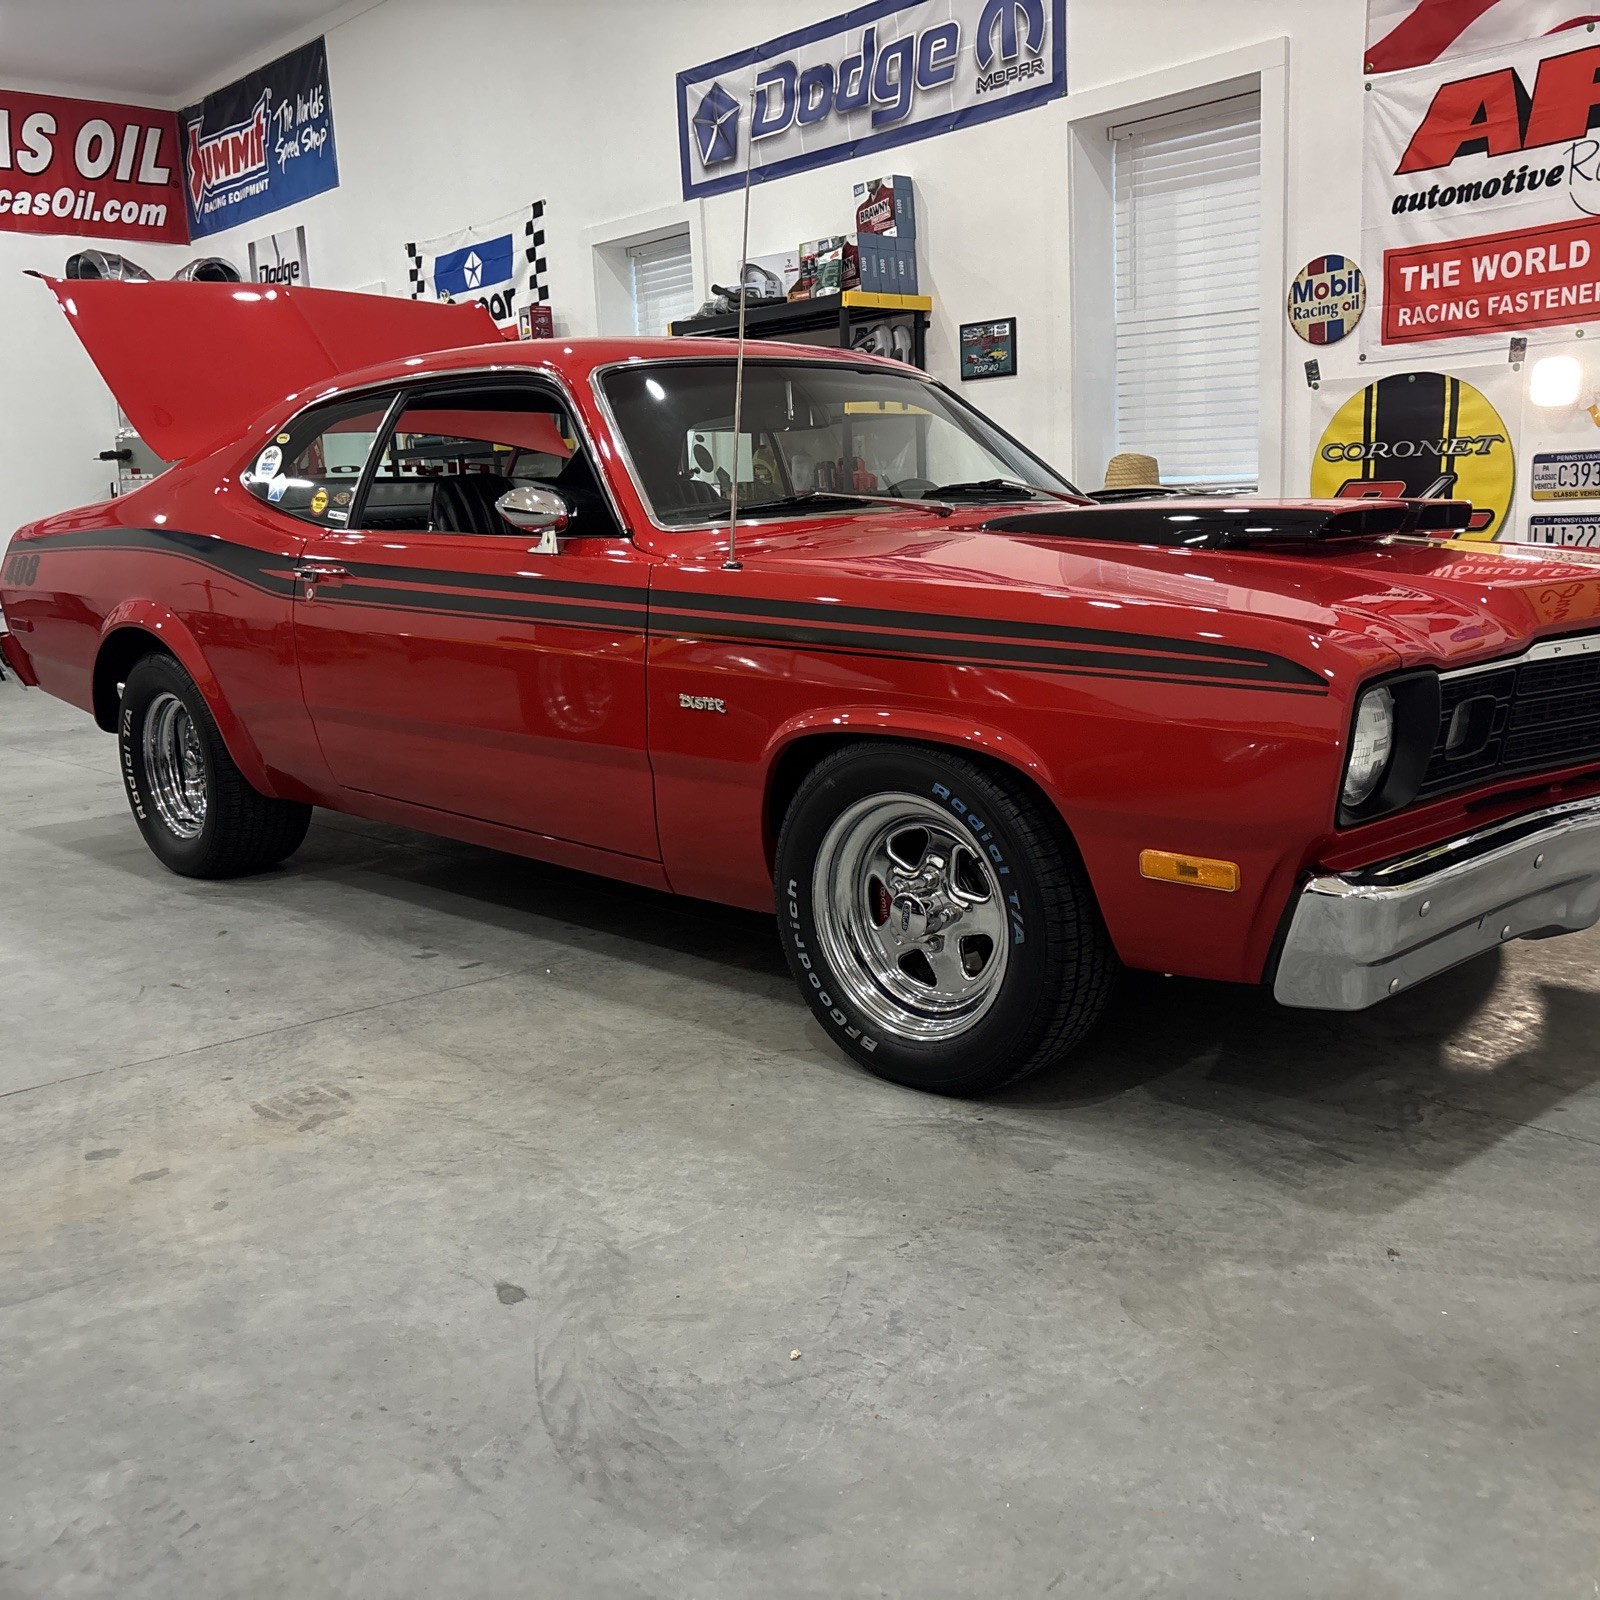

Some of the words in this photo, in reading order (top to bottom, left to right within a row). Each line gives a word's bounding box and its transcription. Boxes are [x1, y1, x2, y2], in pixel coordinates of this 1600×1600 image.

[751, 20, 960, 141] Dodge
[976, 57, 1044, 92] MOPAR
[273, 98, 293, 139] The
[0, 109, 57, 175] S
[74, 119, 171, 184] OIL
[275, 130, 300, 174] Speed
[302, 125, 327, 158] Shop
[1391, 165, 1565, 215] automotive
[860, 200, 889, 222] BRAWNY
[259, 257, 300, 285] Dodge
[1400, 260, 1461, 293] THE
[1472, 239, 1591, 283] WORLD
[1292, 268, 1361, 304] Mobil
[1293, 302, 1339, 320] Racing
[1342, 294, 1359, 311] oil
[1397, 298, 1480, 327] RACING
[973, 364, 988, 373] TOP
[988, 363, 999, 372] 40
[1321, 434, 1505, 463] CORONET
[1534, 473, 1558, 481] CLASSIC
[1542, 464, 1550, 472] PA
[1534, 482, 1557, 490] VEHICLE
[679, 693, 727, 714] DUSTER
[123, 709, 133, 738] T/A
[125, 745, 147, 821] Radial
[931, 782, 1010, 875] Radial
[1008, 890, 1025, 946] T/A
[787, 879, 878, 1053] BFGoodrich
